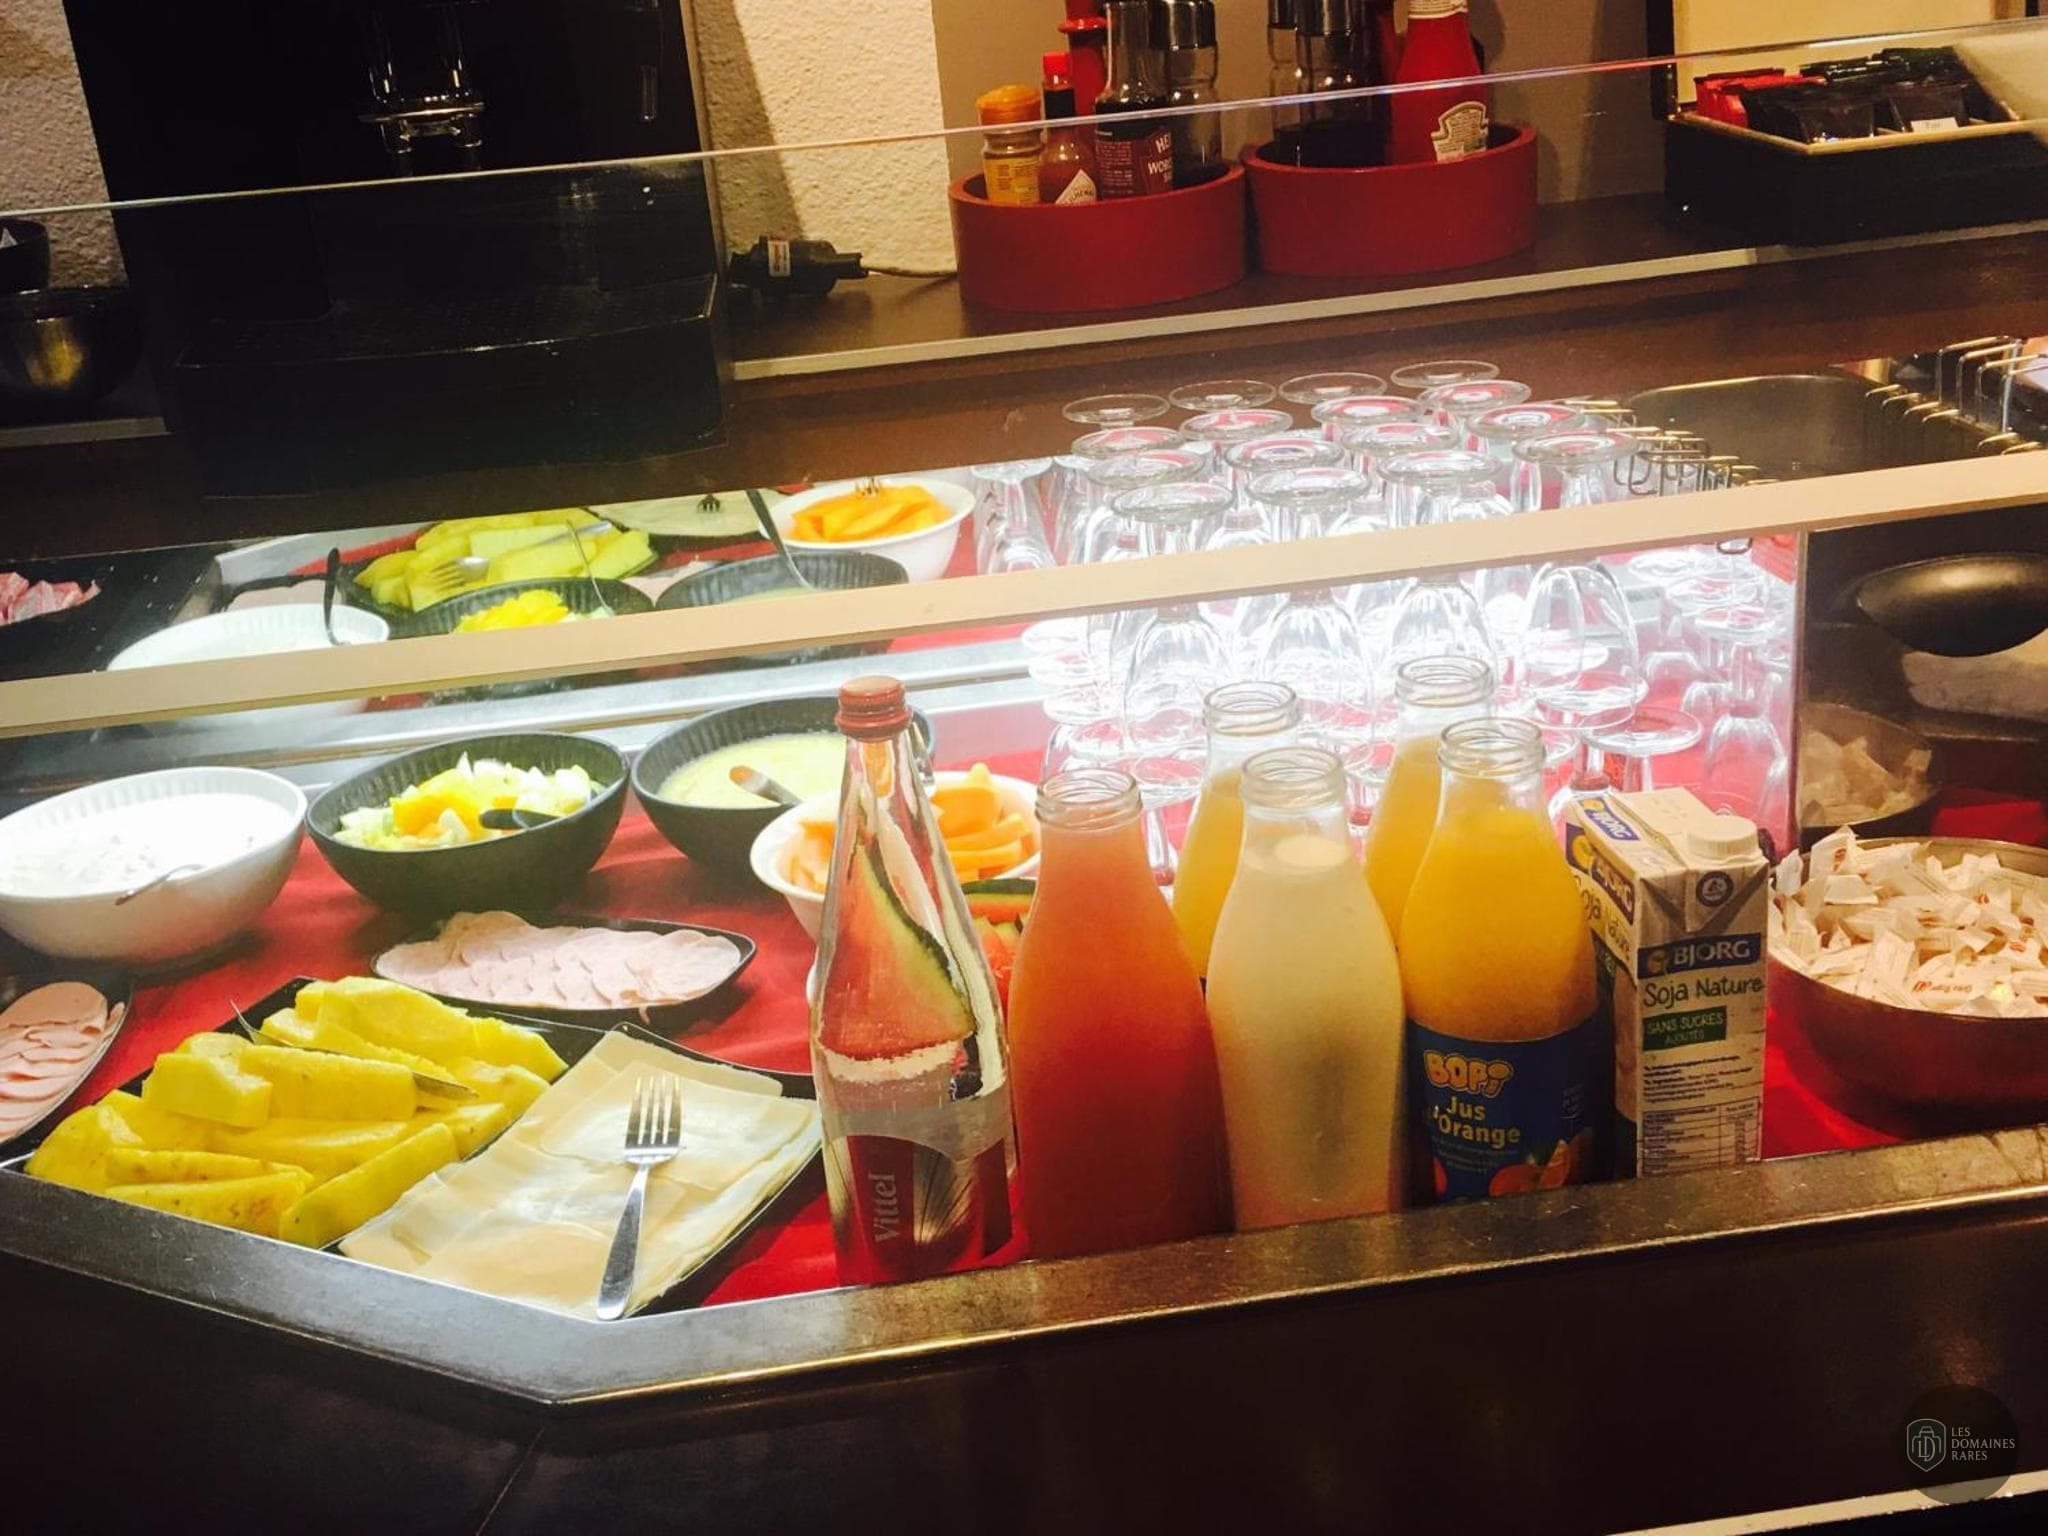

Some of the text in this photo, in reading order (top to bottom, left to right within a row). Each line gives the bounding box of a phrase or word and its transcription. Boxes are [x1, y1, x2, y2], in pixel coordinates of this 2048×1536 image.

[1674, 940, 1750, 966] BJORG
[1644, 976, 1764, 1009] Soja Nature
[1680, 1012, 1724, 1030] SUCRES
[1448, 1097, 1486, 1121] Jus
[868, 1172, 899, 1243] Vittel
